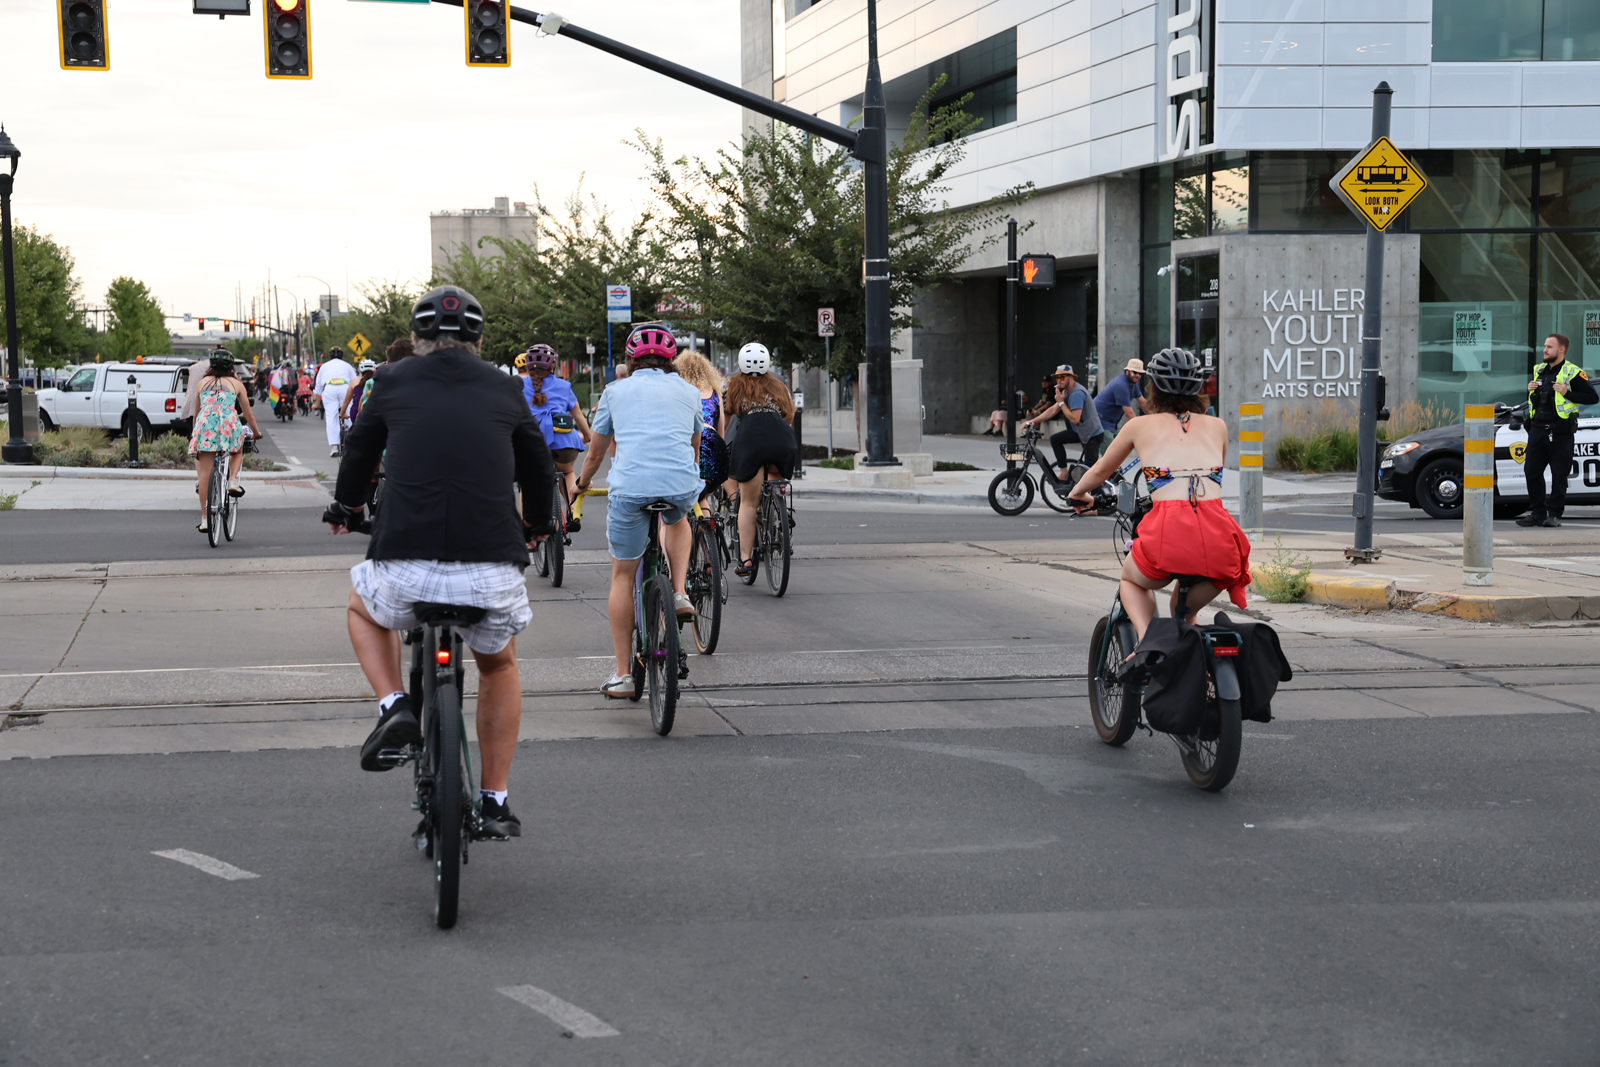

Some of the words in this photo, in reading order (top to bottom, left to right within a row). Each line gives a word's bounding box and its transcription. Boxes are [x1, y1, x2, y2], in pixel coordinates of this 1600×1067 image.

[1365, 197, 1380, 205] LOOK
[1383, 197, 1399, 205] BOTH
[1263, 288, 1365, 312] KAHLER
[1456, 313, 1468, 321] SPY
[1469, 313, 1481, 321] HOP
[1586, 313, 1597, 321] SPY
[1456, 330, 1476, 338] YOUTH
[1263, 347, 1362, 381] MEDI
[1262, 382, 1308, 398] ARTS
